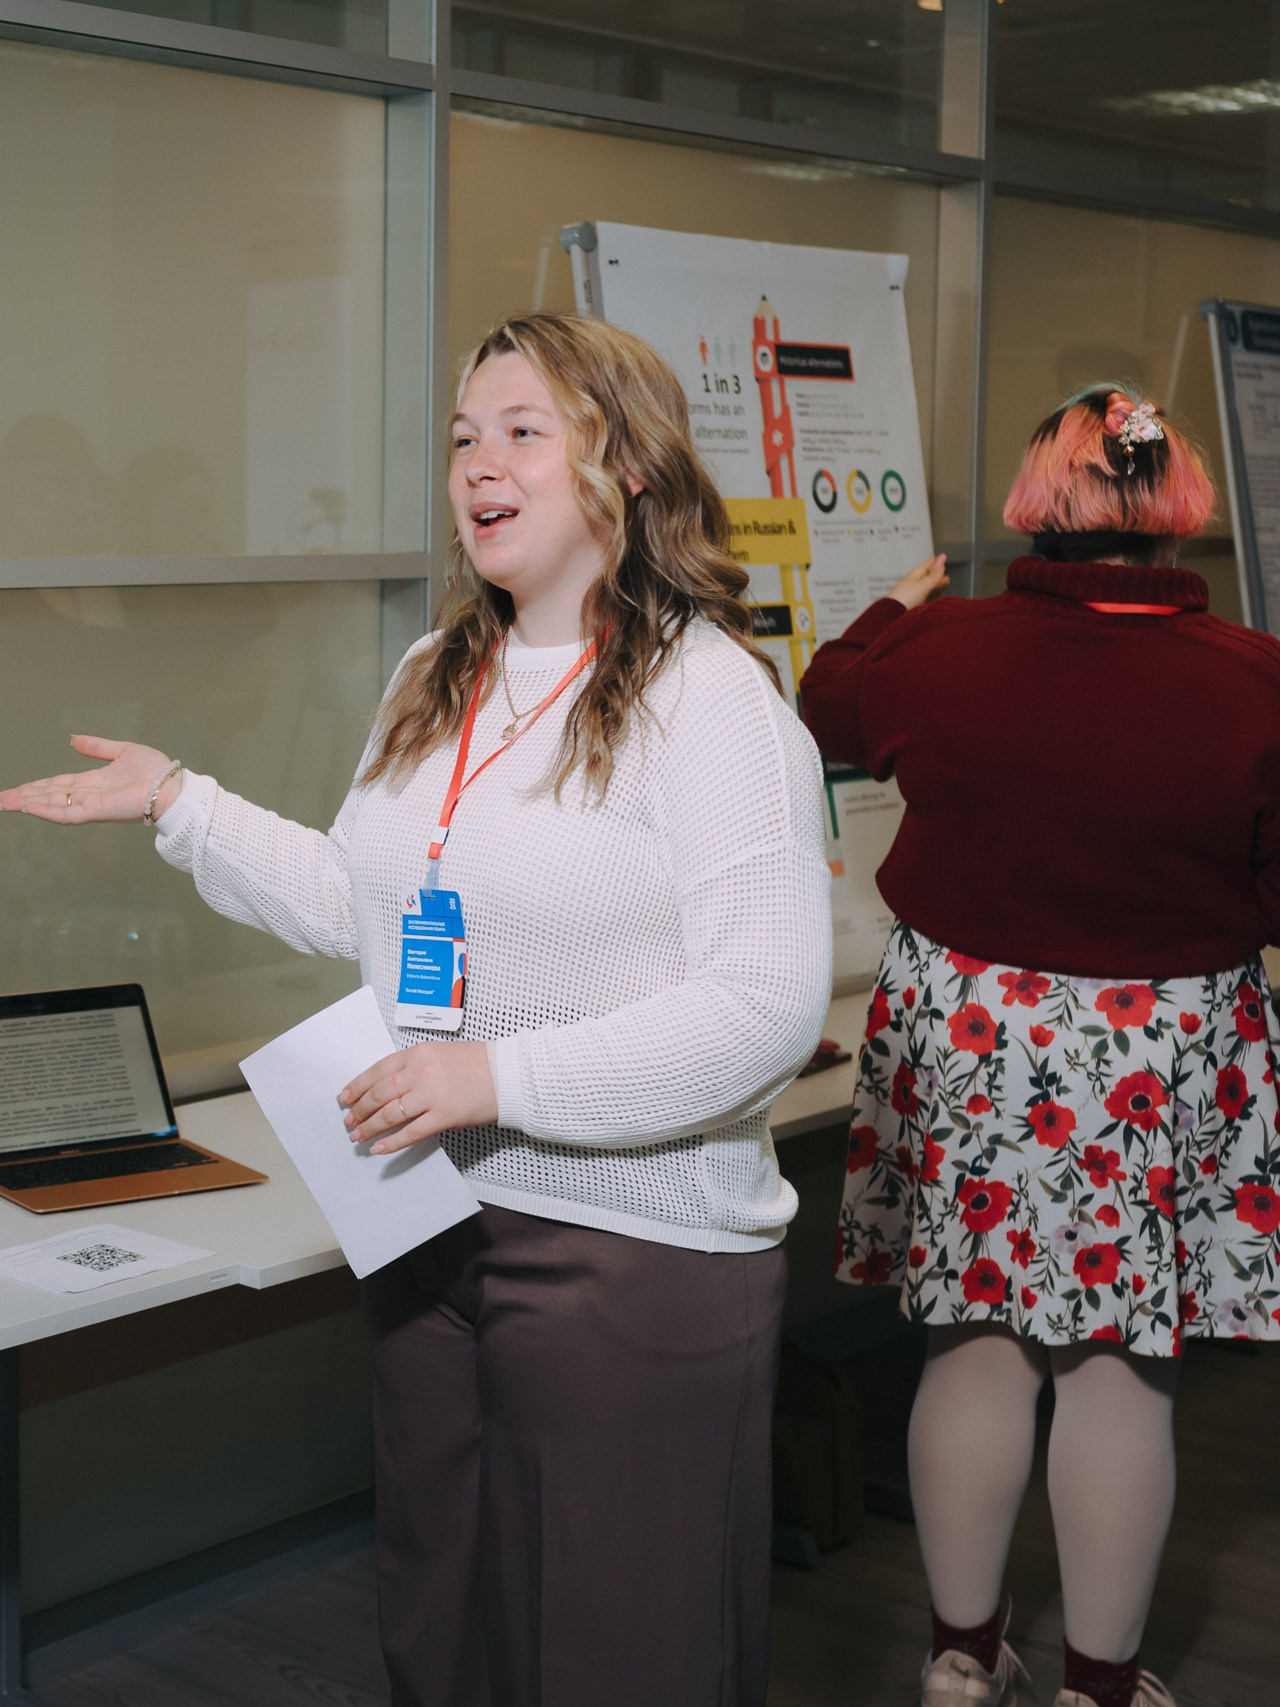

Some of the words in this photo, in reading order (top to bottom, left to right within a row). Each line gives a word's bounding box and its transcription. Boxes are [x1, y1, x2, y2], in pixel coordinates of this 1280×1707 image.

[702, 374, 711, 392] 1
[714, 372, 728, 394] in
[733, 374, 741, 394] 3
[714, 400, 730, 416] has
[696, 425, 748, 440] alternation
[753, 520, 788, 535] Russian
